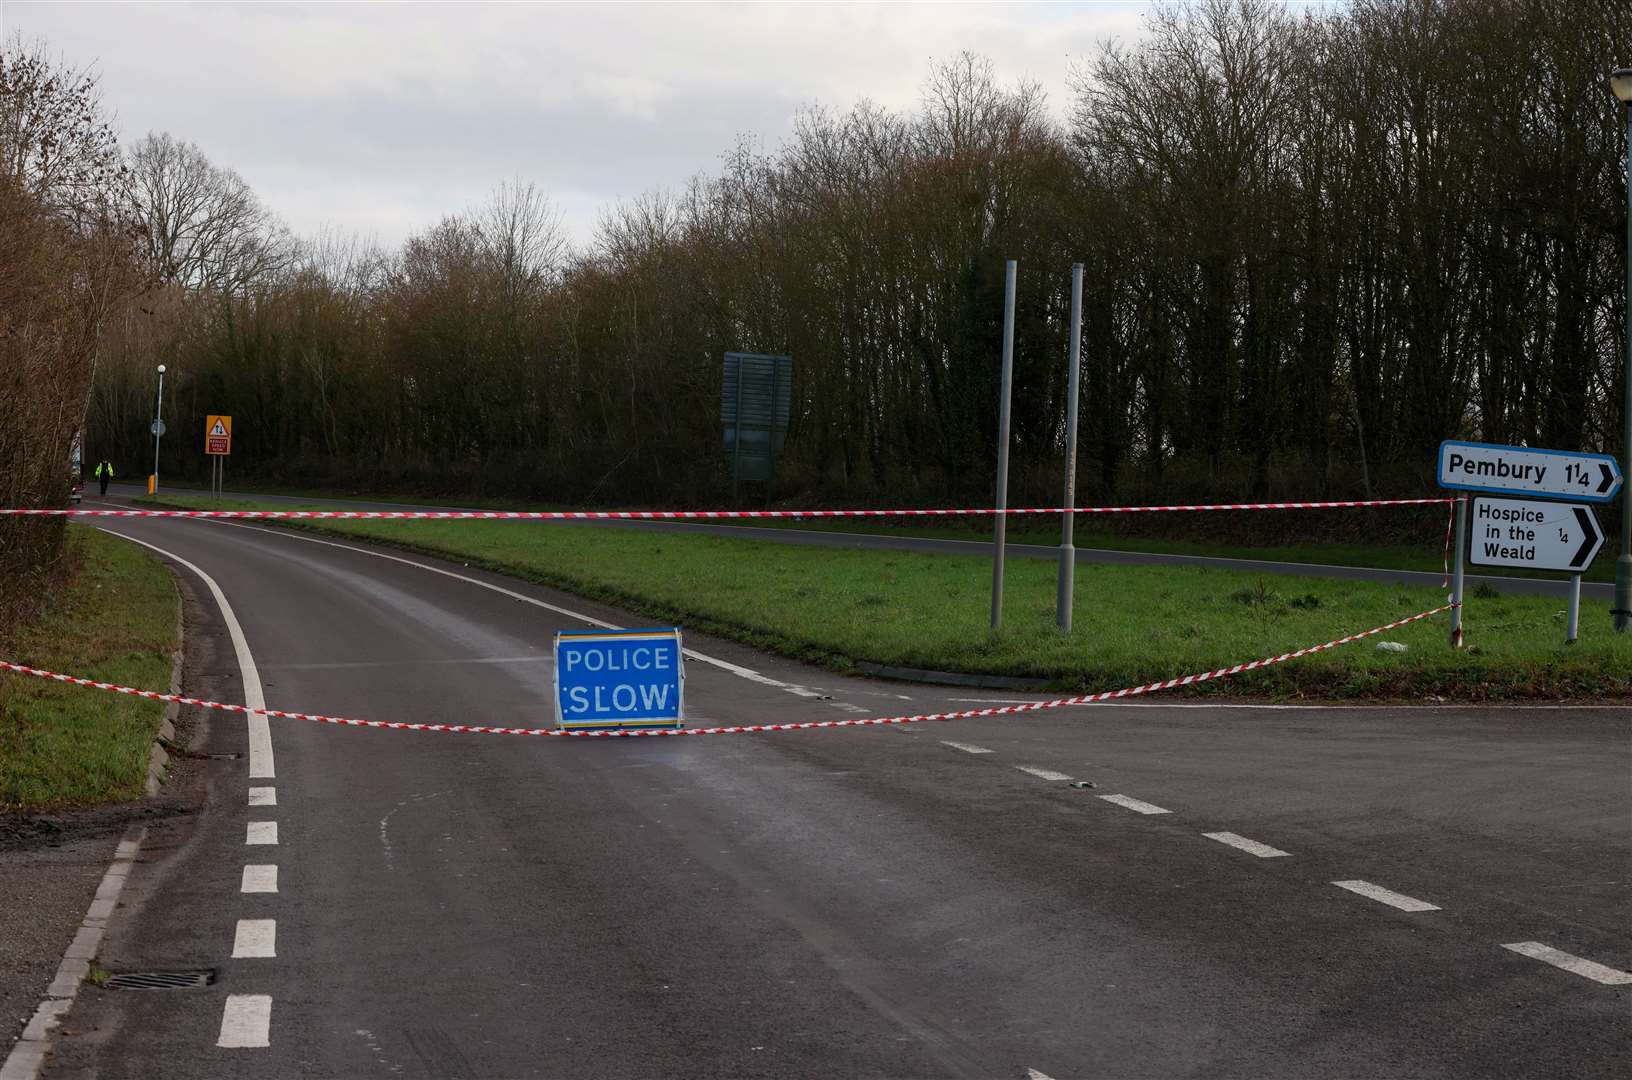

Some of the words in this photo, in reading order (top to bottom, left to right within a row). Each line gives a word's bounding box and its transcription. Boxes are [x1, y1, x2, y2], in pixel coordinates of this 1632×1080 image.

[1449, 454, 1547, 484] Pembury
[1479, 504, 1544, 523] Hospice
[1486, 524, 1500, 539] in
[1509, 525, 1535, 541] the
[1484, 542, 1535, 560] Weald
[566, 647, 670, 672] POLICE
[569, 683, 669, 713] SLOW
